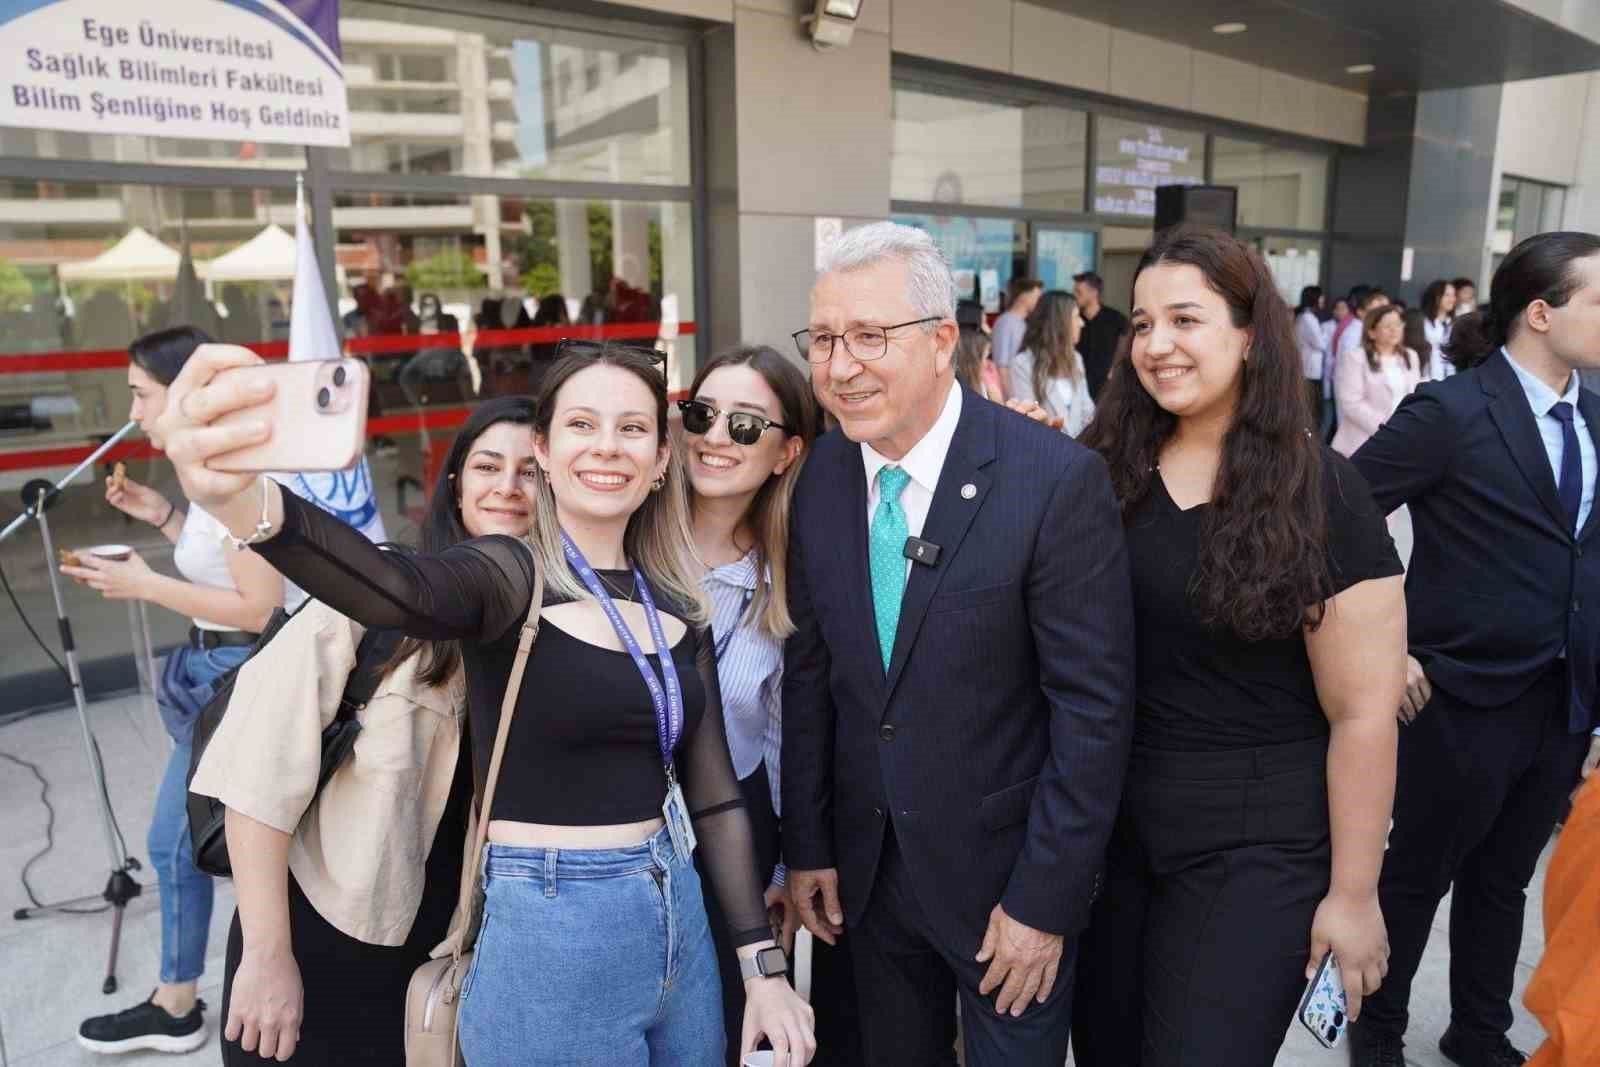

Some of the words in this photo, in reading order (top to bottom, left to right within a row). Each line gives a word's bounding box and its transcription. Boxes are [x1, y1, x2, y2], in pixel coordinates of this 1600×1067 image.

[82, 18, 129, 47] Ege
[139, 20, 273, 60] Üniversitesi
[26, 48, 110, 80] Sağlık
[118, 59, 218, 89] Bilimleri
[226, 69, 324, 97] Fakültesi
[12, 84, 81, 112] Bilim
[90, 91, 202, 122] Şenliğine
[211, 102, 251, 128] Hoş
[259, 105, 340, 129] Geldiniz
